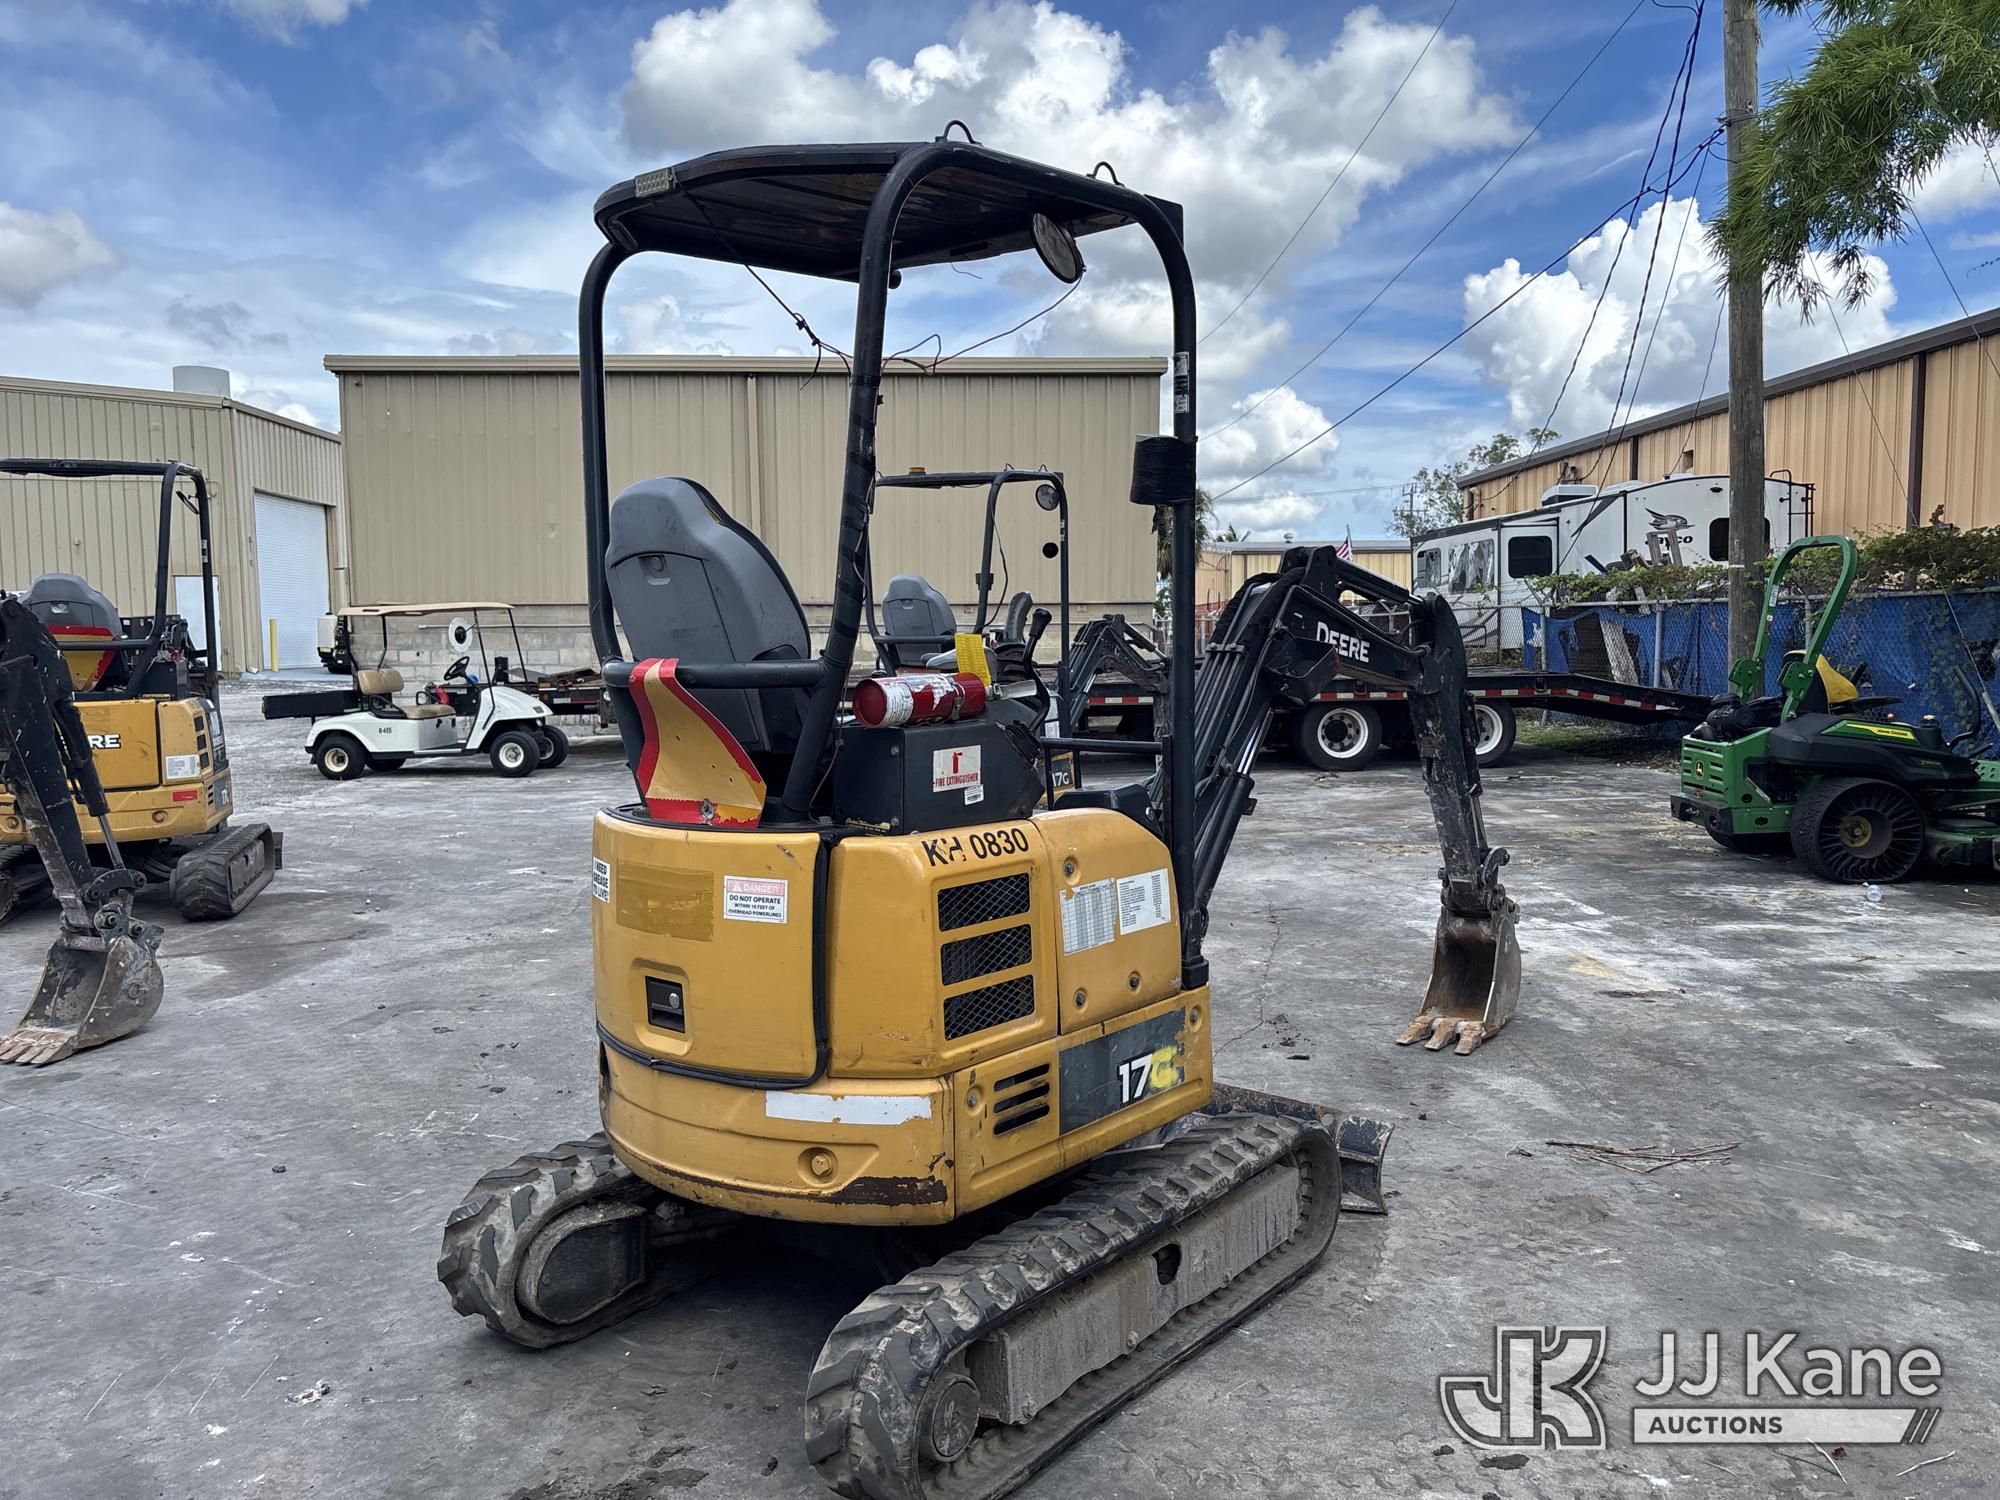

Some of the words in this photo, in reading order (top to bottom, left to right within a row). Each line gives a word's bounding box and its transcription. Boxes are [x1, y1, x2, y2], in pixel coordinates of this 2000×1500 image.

[1316, 621, 1370, 663] DEERE
[936, 777, 945, 787] FIRE
[947, 773, 978, 785] EXTINGUISHER
[969, 828, 1029, 859] 0830
[597, 861, 607, 875] NEED
[743, 883, 778, 893] DANGER
[753, 896, 781, 904] OPERATE
